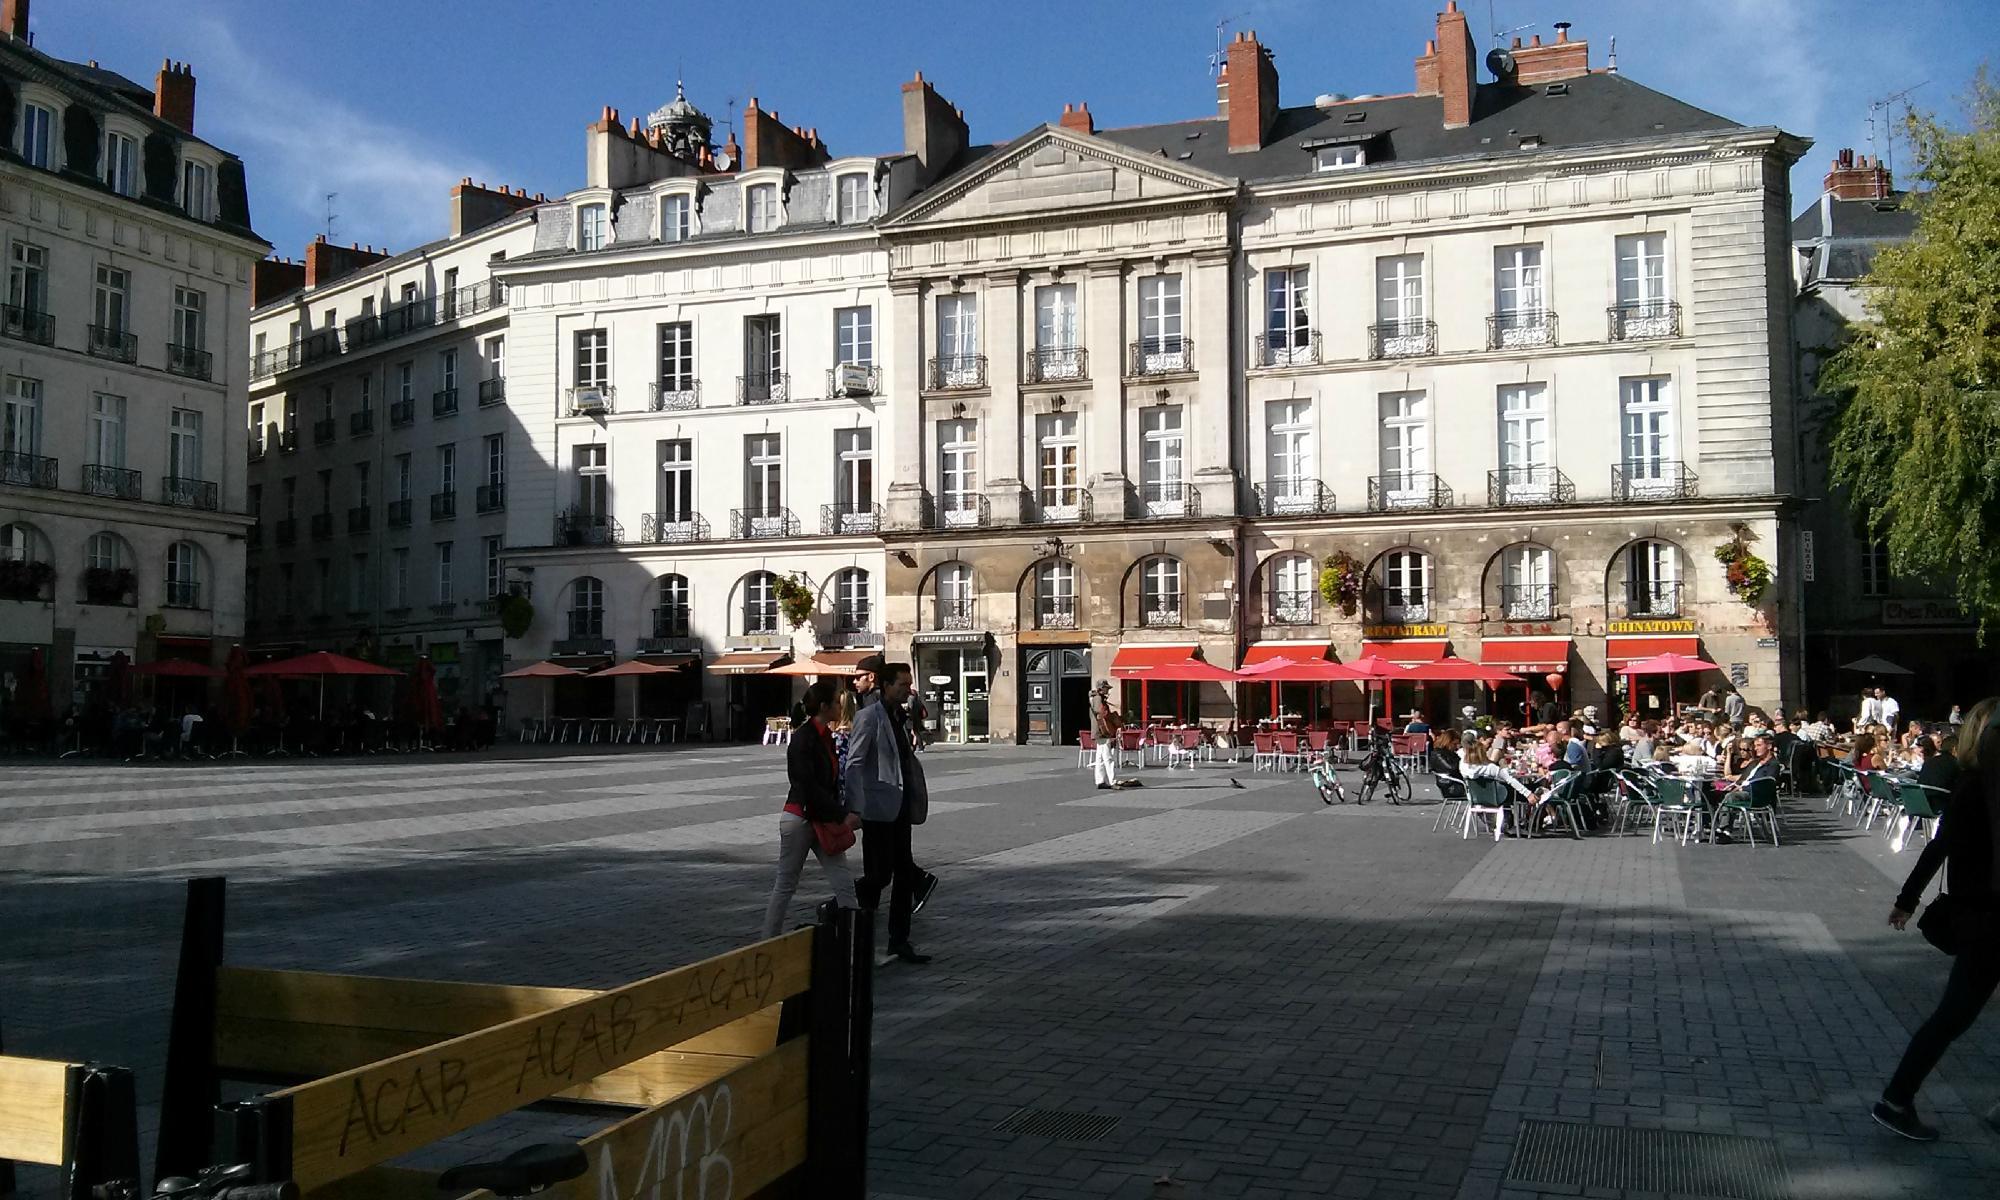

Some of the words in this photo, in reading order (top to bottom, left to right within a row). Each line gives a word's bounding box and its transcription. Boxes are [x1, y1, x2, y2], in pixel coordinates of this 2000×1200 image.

[1804, 532, 1812, 580] CHINATOWN
[1366, 625, 1447, 636] RESTAURANT
[1609, 621, 1695, 633] CHINATOWN
[677, 952, 774, 1025] ACAB
[516, 995, 637, 1094] ACAB
[338, 1058, 470, 1157] ACAB
